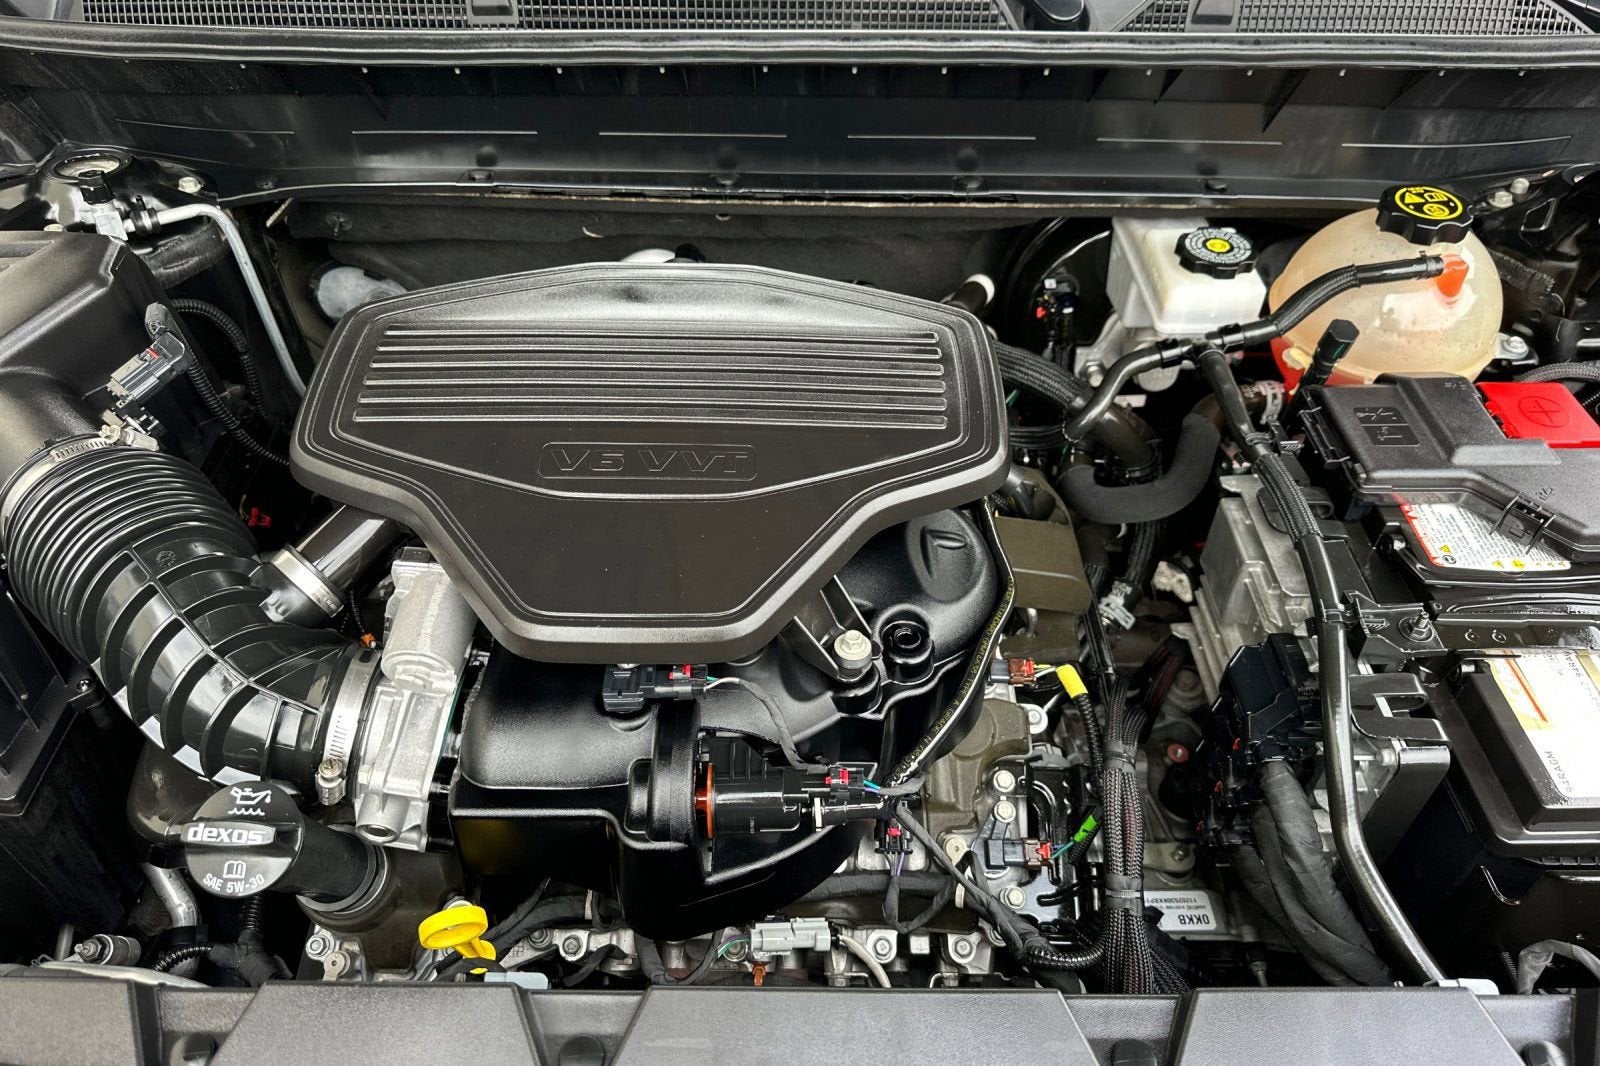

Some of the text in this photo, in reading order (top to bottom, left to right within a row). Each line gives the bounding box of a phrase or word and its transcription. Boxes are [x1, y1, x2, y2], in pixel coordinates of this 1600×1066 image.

[550, 449, 749, 473] V6 VVT
[961, 674, 976, 698] TYPE
[930, 708, 954, 735] GRADE
[923, 735, 933, 744] N
[187, 823, 267, 845] dexos
[203, 872, 266, 893] SAE 5W-30
